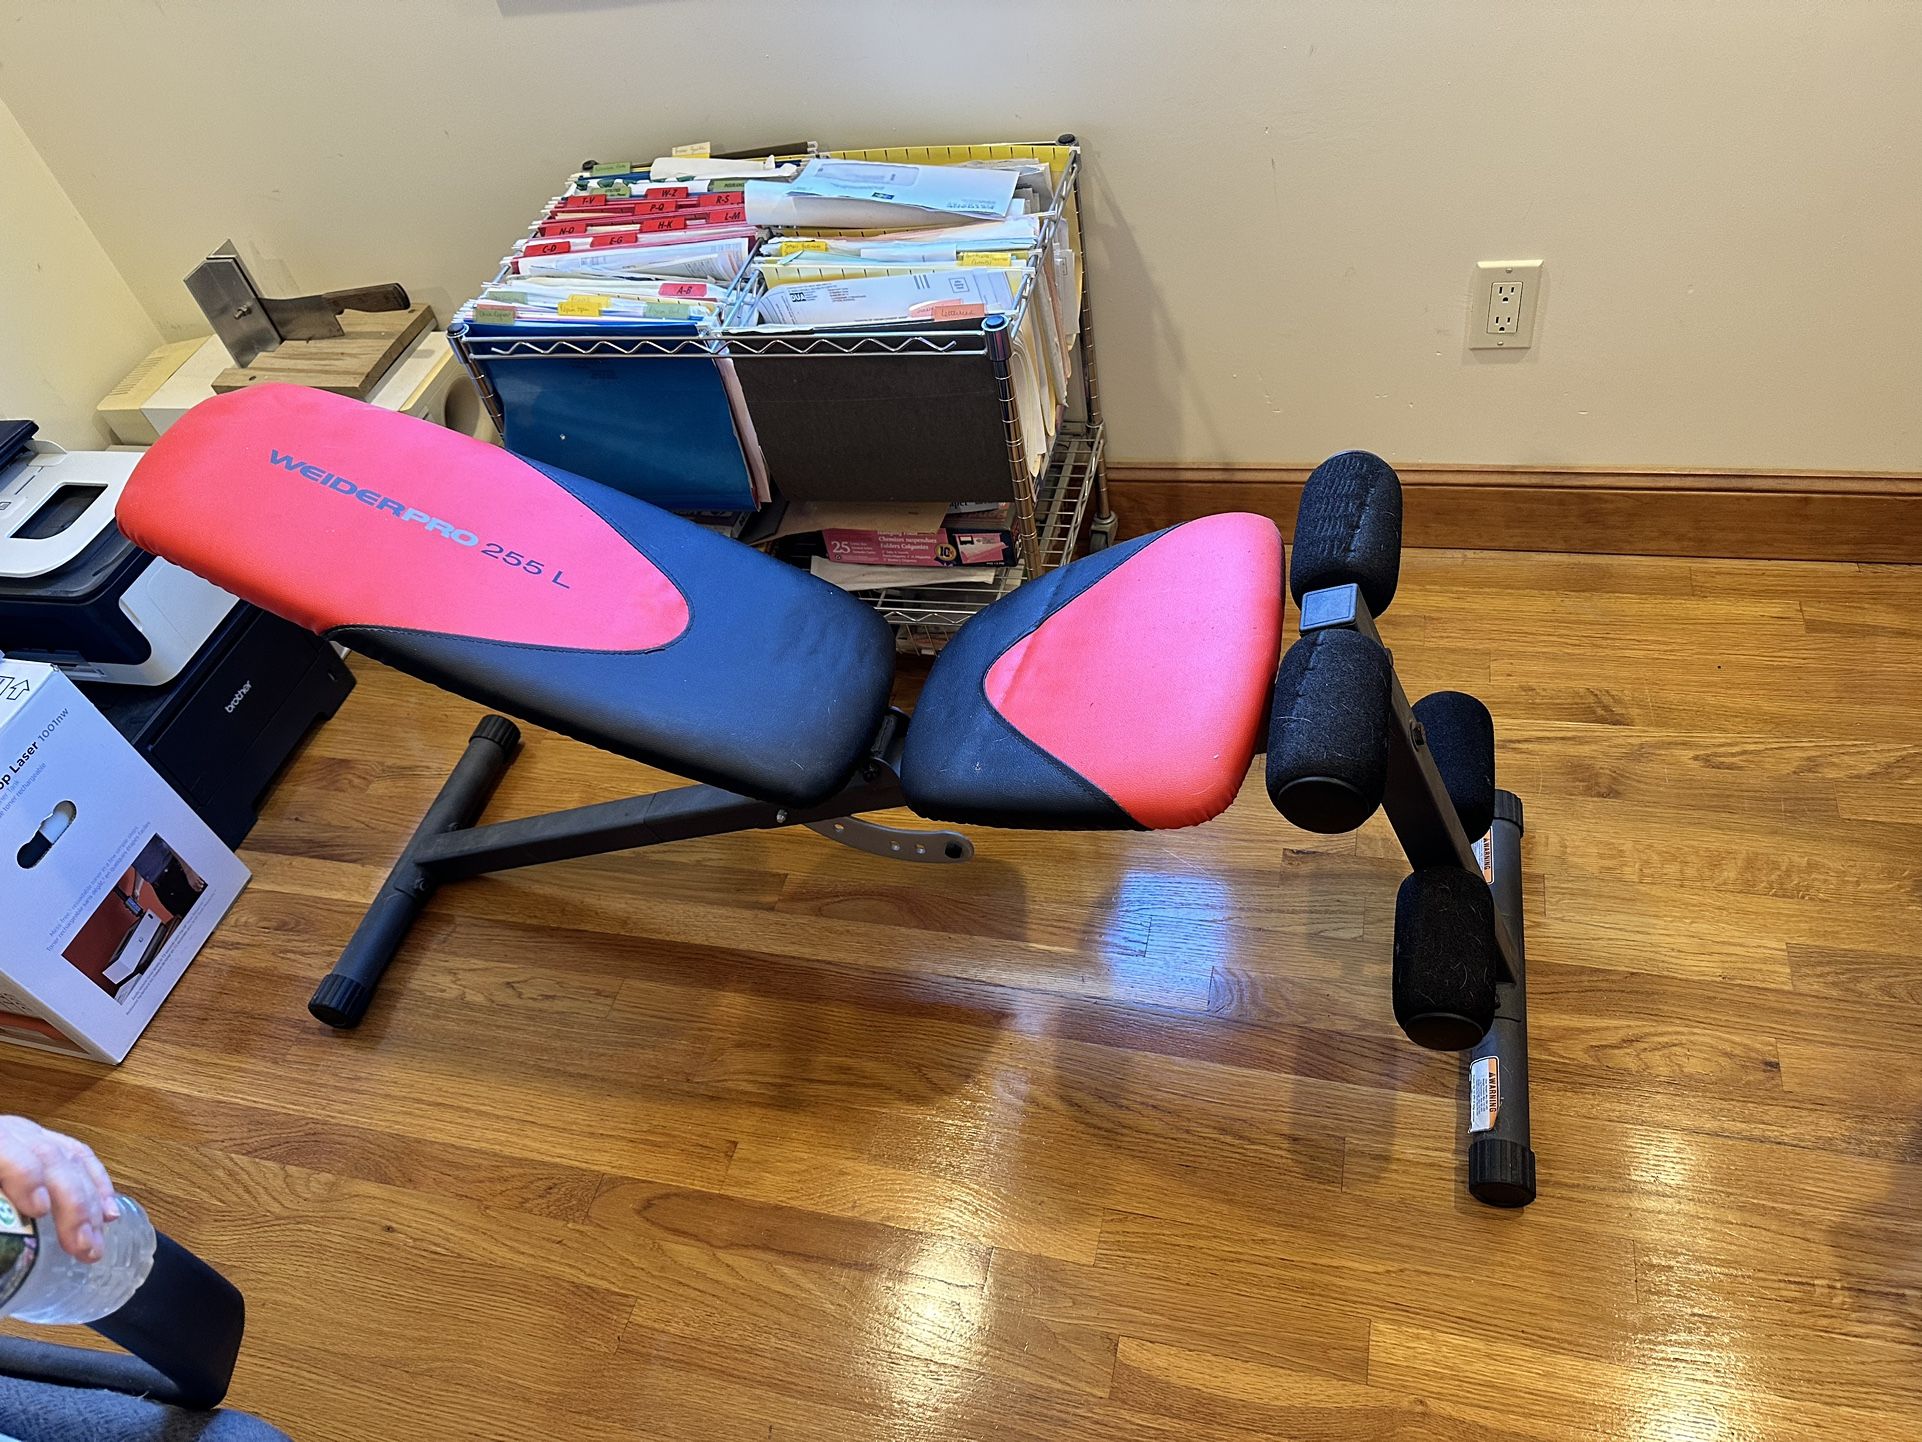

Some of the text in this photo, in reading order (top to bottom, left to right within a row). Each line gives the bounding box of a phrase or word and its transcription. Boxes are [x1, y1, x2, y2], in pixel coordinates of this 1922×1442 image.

[661, 189, 678, 197] W-Z
[581, 196, 595, 205] T-V
[715, 195, 730, 203] R-S
[650, 204, 664, 212] P-Q
[724, 212, 741, 220] L-M
[657, 220, 673, 228] H-K
[559, 226, 575, 235] N-O
[608, 236, 623, 245] E-G
[542, 244, 557, 253] C-D
[677, 285, 692, 295] A-B
[831, 541, 851, 554] 25
[481, 542, 545, 576] 255
[551, 570, 571, 589] L
[224, 680, 252, 714] brother
[9, 741, 38, 774] Laser
[38, 707, 69, 743] 1001nw
[1488, 1077, 1497, 1113] WARNING
